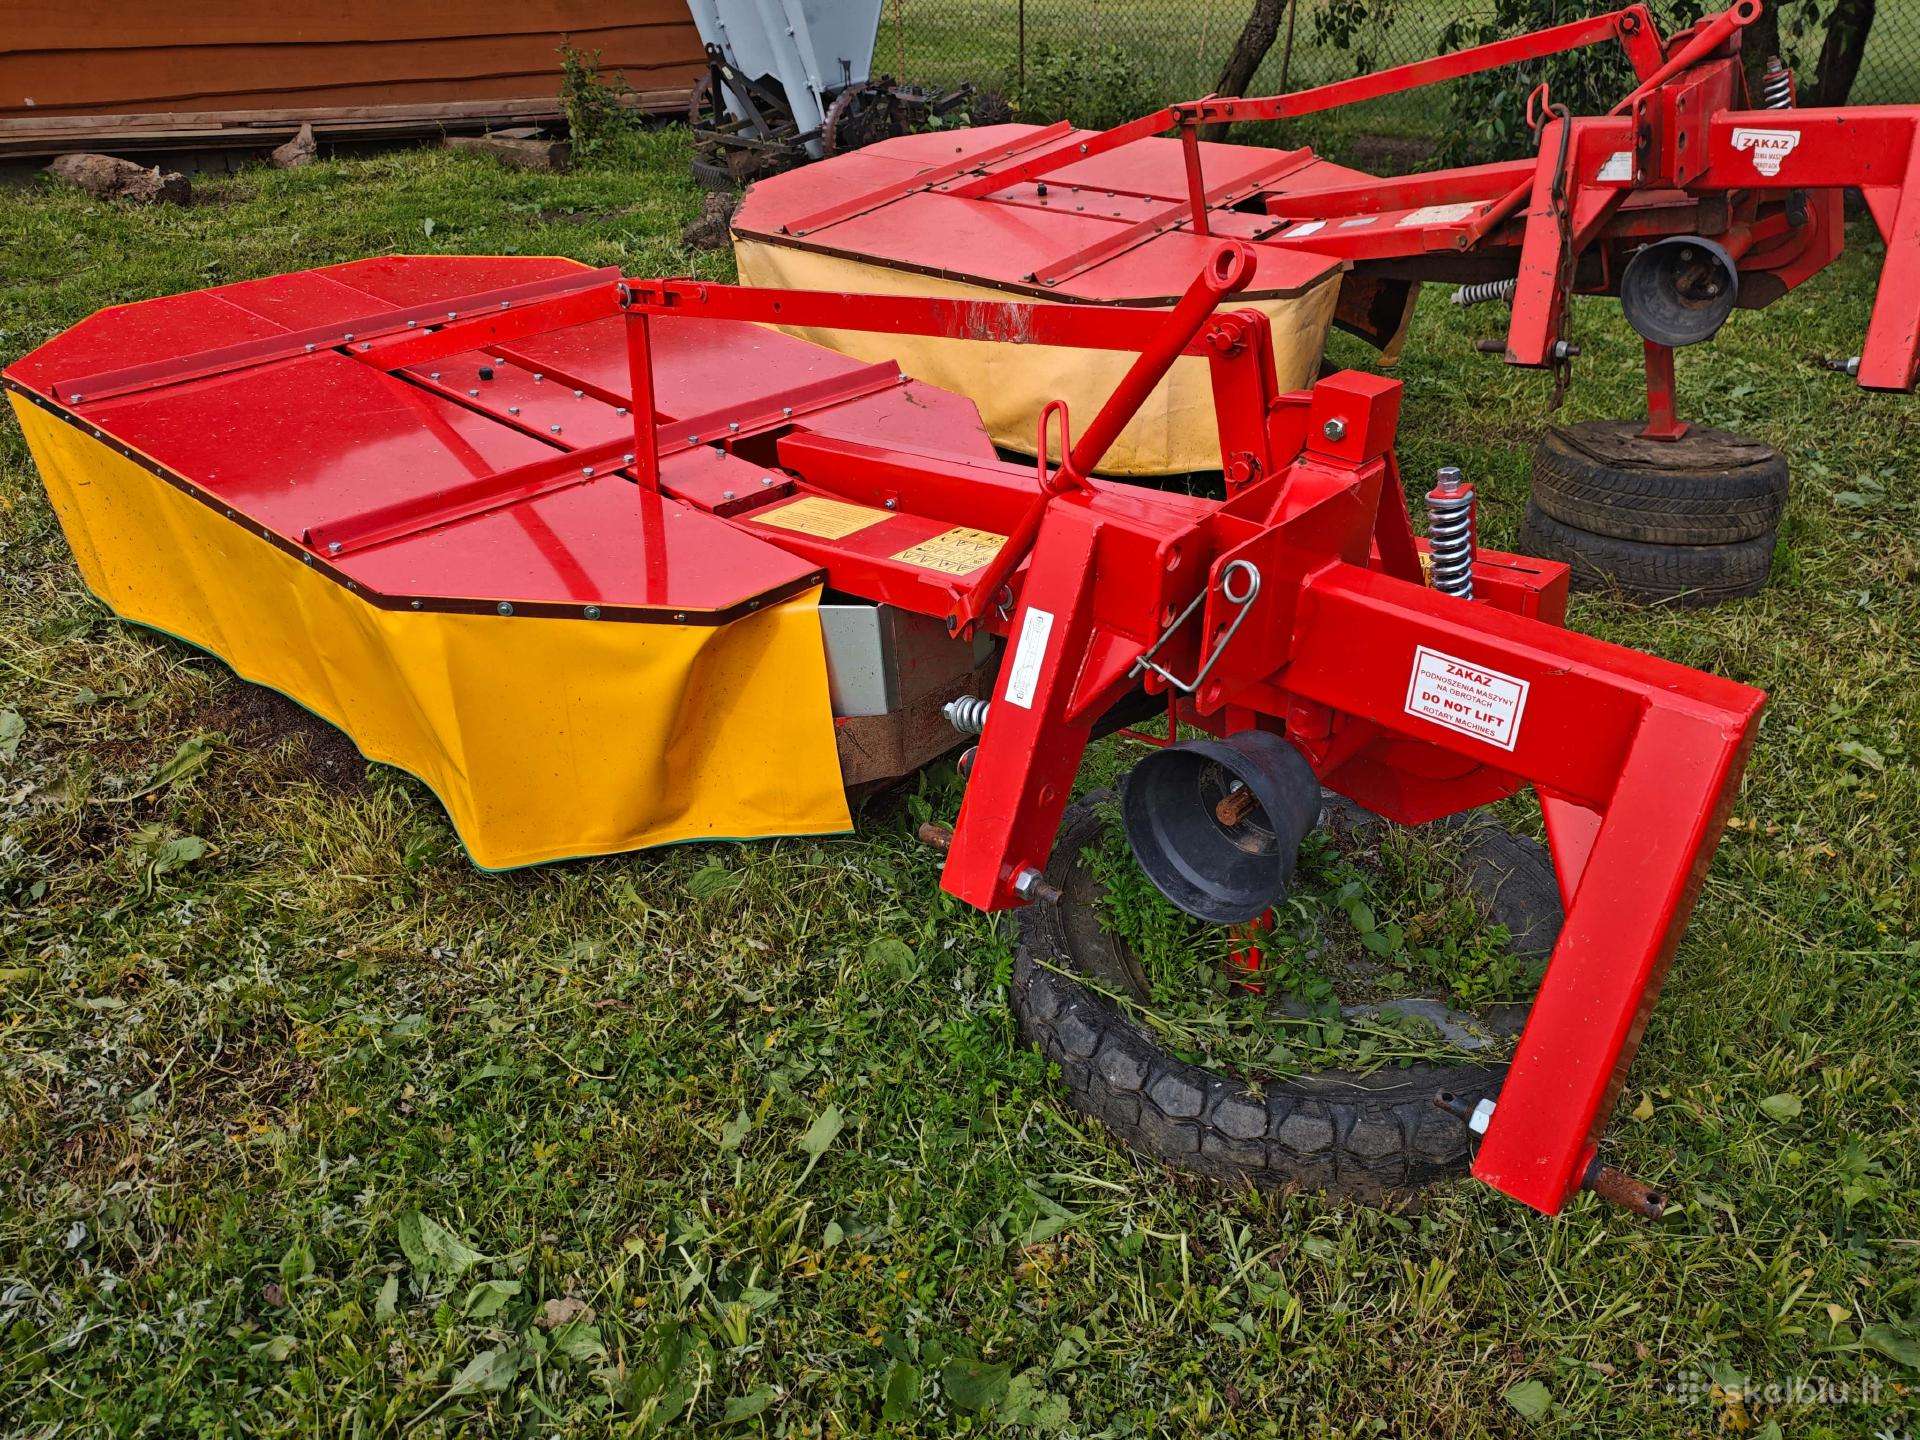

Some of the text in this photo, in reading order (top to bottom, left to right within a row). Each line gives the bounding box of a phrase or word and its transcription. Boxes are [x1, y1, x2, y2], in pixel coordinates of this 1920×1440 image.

[1743, 138, 1789, 149] ZAKAZ
[1420, 669, 1514, 707] PODNOSZENIA MASZYNY
[1446, 664, 1492, 687] ZAKAZ
[1421, 691, 1505, 727] DO NOT LIFT
[1436, 684, 1493, 708] NA OBROTACH
[1423, 705, 1496, 737] ROTARY MACHINES
